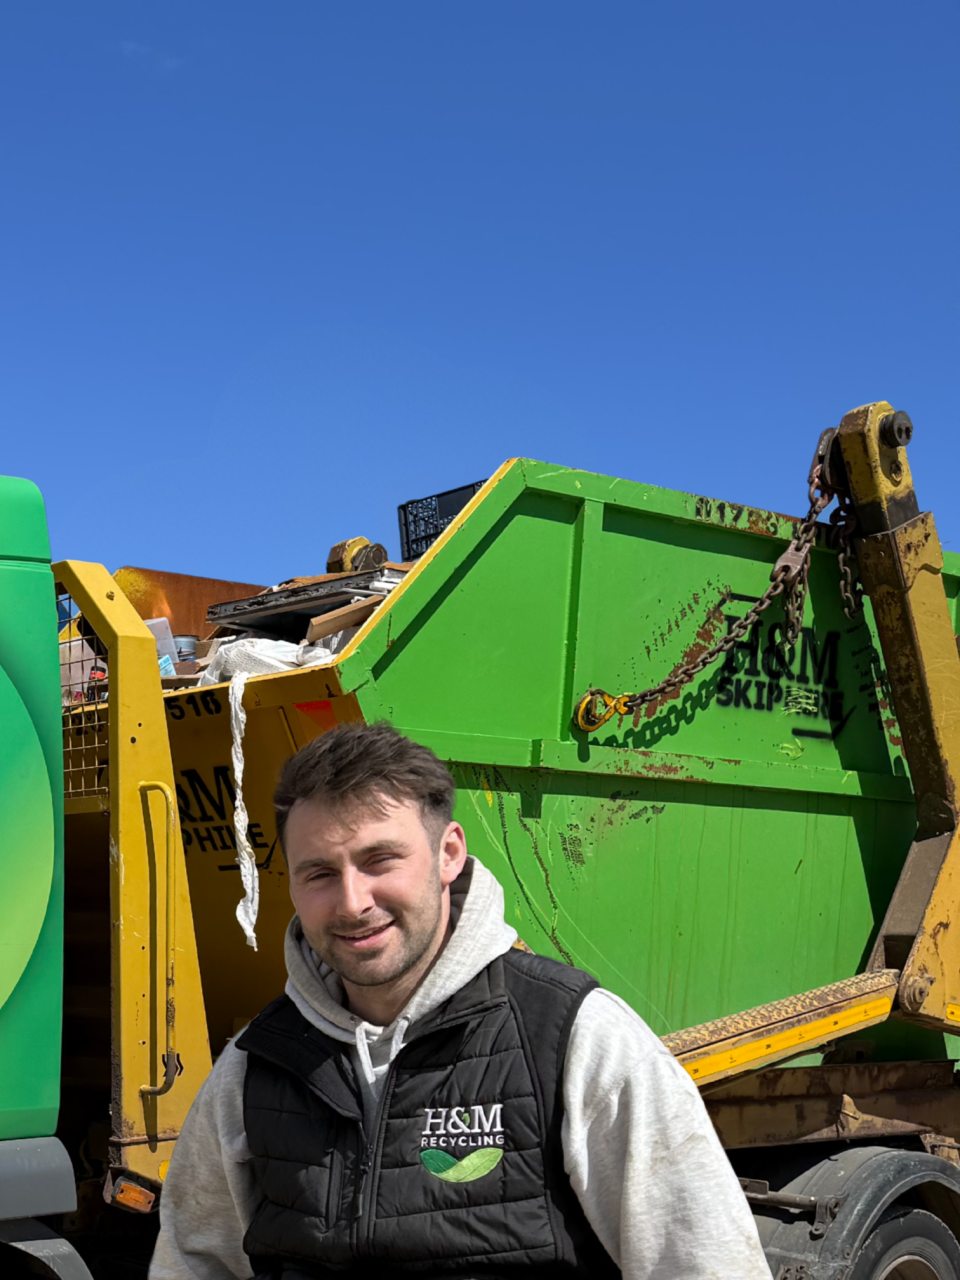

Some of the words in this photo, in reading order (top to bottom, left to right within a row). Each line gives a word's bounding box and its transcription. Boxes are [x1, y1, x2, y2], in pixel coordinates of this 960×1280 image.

[723, 613, 840, 690] H&M
[164, 690, 222, 721] 516
[716, 676, 783, 712] SKIP
[421, 1104, 505, 1135] H&M
[420, 1134, 505, 1148] RECYCLING
